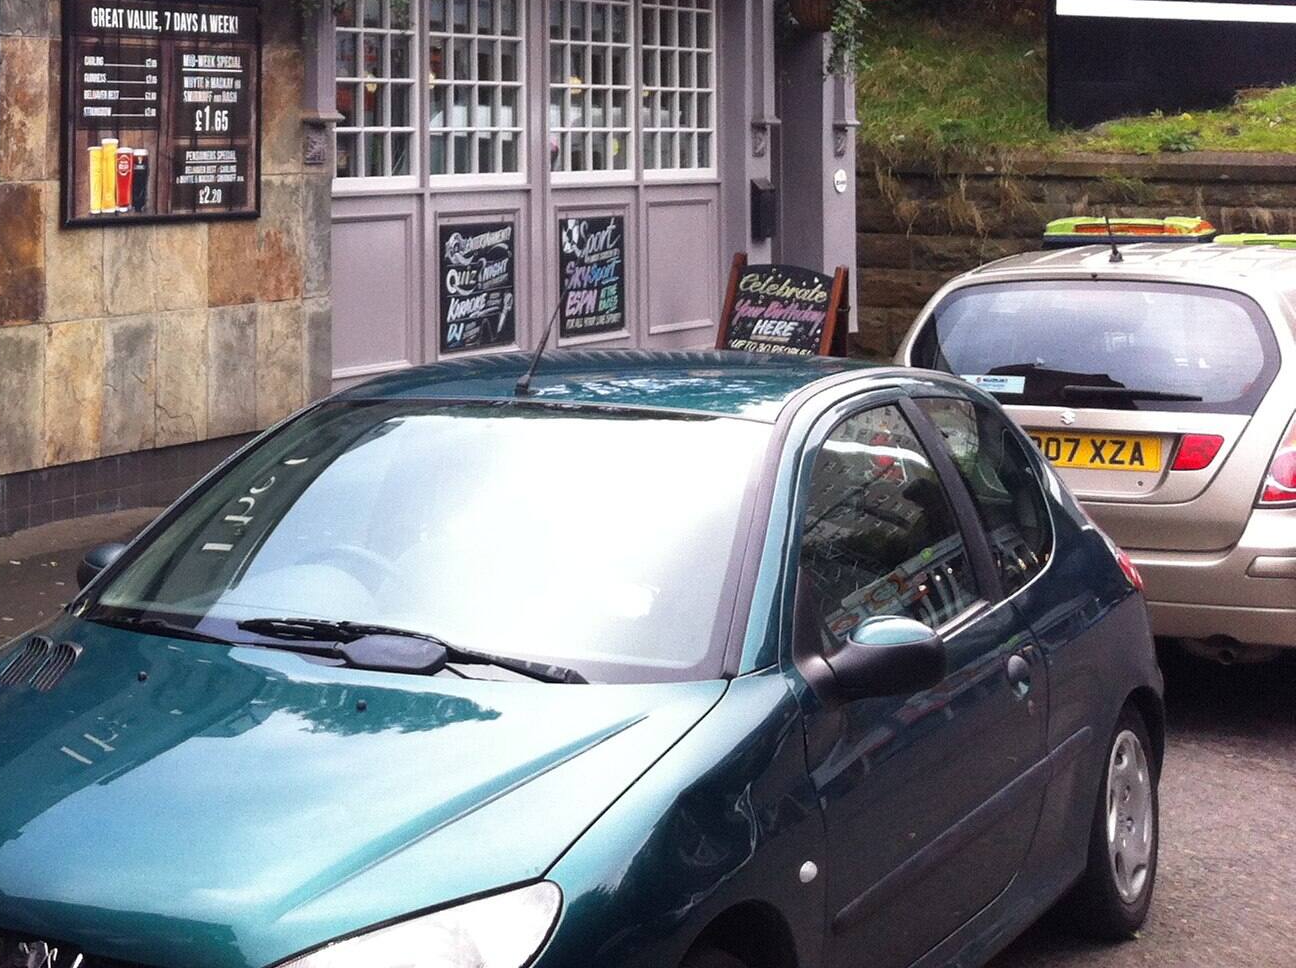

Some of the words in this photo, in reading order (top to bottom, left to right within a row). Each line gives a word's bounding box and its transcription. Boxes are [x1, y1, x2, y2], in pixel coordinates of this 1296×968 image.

[91, 7, 124, 28] GREAT
[127, 9, 162, 32] VALUE,
[164, 11, 171, 30] 7
[173, 12, 198, 32] DAYS
[201, 13, 208, 32] A
[209, 14, 239, 34] WEEK!
[195, 105, 229, 131] £1.65
[739, 273, 827, 303] Celebrate
[752, 319, 799, 337] HERE
[1090, 439, 1144, 466] XZA
